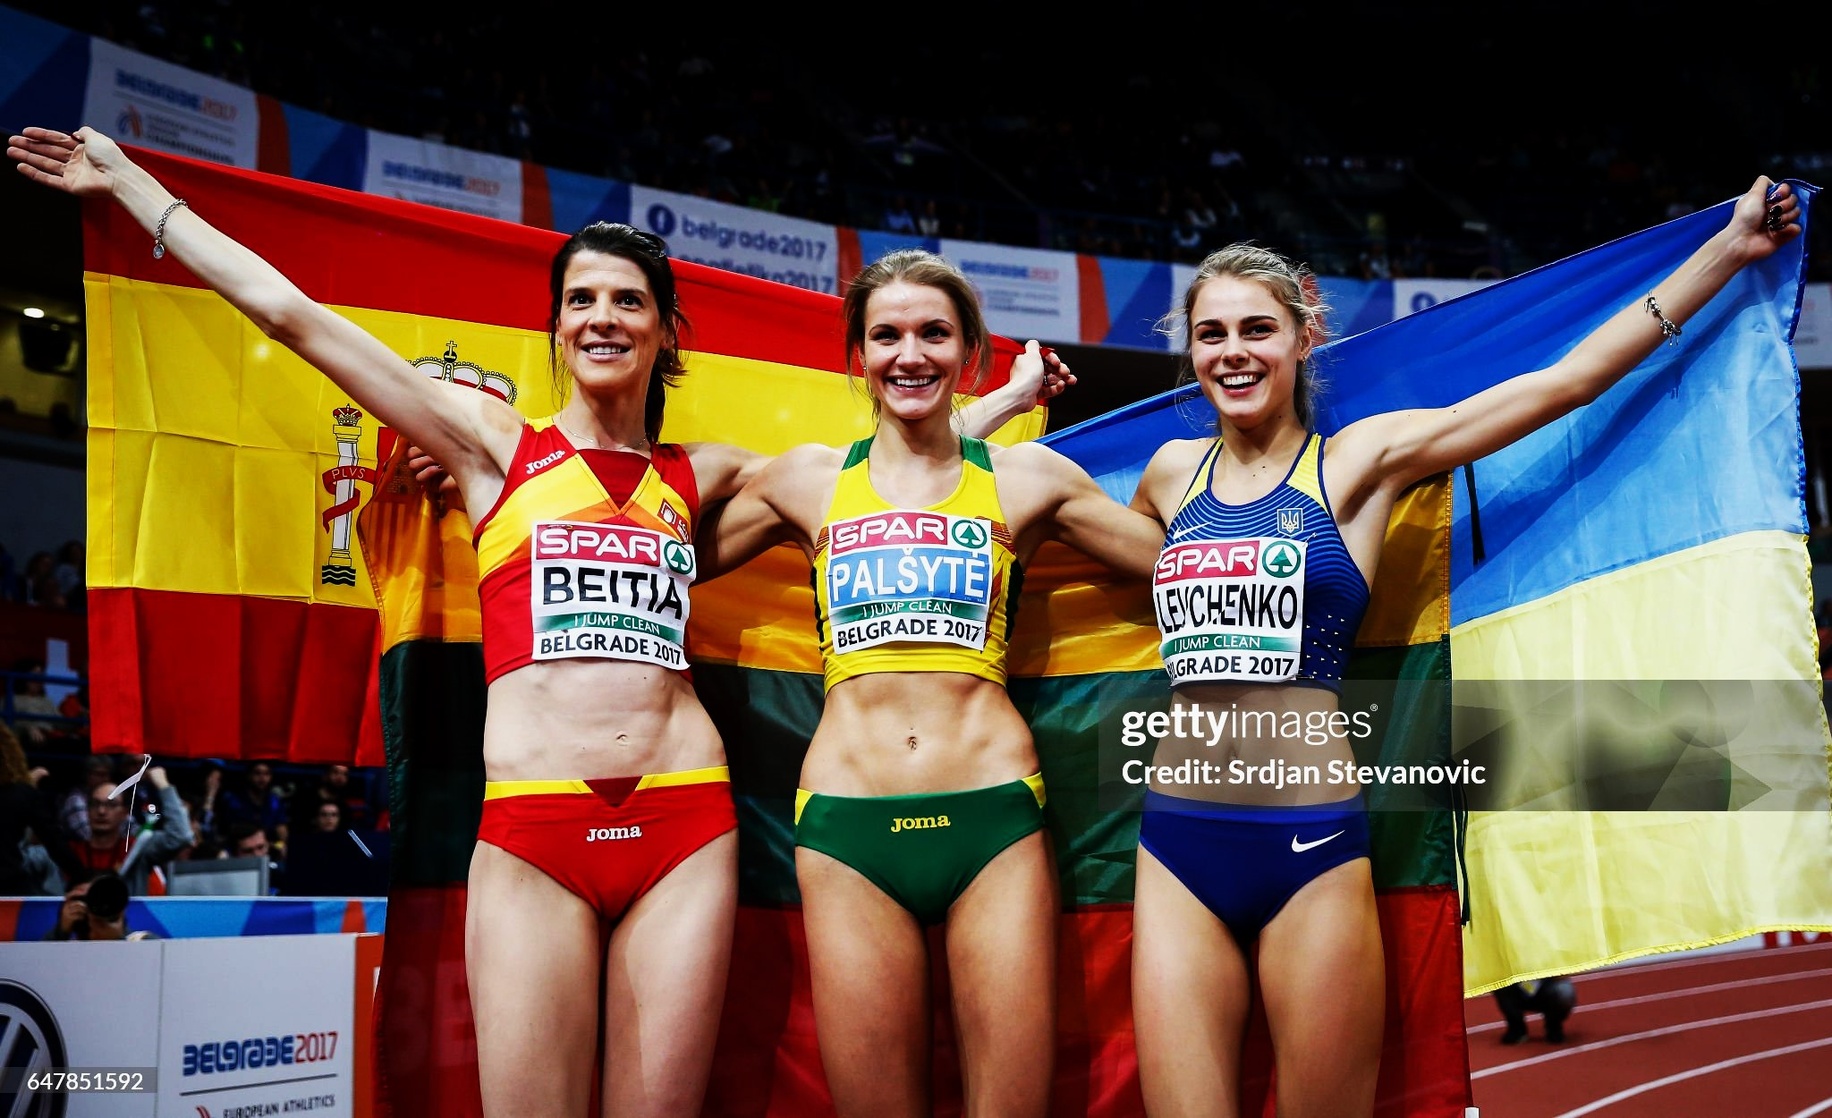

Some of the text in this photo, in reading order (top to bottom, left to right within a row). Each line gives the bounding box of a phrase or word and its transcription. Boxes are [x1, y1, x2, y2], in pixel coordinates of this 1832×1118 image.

[682, 214, 827, 262] belgrade2017
[331, 468, 366, 480] PLVS
[526, 450, 565, 474] Joma
[834, 516, 945, 549] SPAR
[539, 528, 658, 562] SPAR
[1157, 546, 1254, 579] SPAR
[543, 567, 682, 620] BEITIA
[870, 602, 905, 618] JUMP
[909, 600, 952, 615] CLEAN
[581, 614, 619, 628] JUMP
[623, 616, 660, 635] CLEAN
[838, 619, 982, 648] BELGRADE 2017
[540, 633, 681, 665] BELGRADE 2017
[1179, 637, 1208, 653] JUMP
[1214, 635, 1261, 649] CLEAN
[1248, 657, 1294, 676] 2017
[586, 825, 642, 842] Joma
[890, 815, 951, 833] Joma
[223, 1094, 336, 1118] EUROPEAN ATHLETICS
